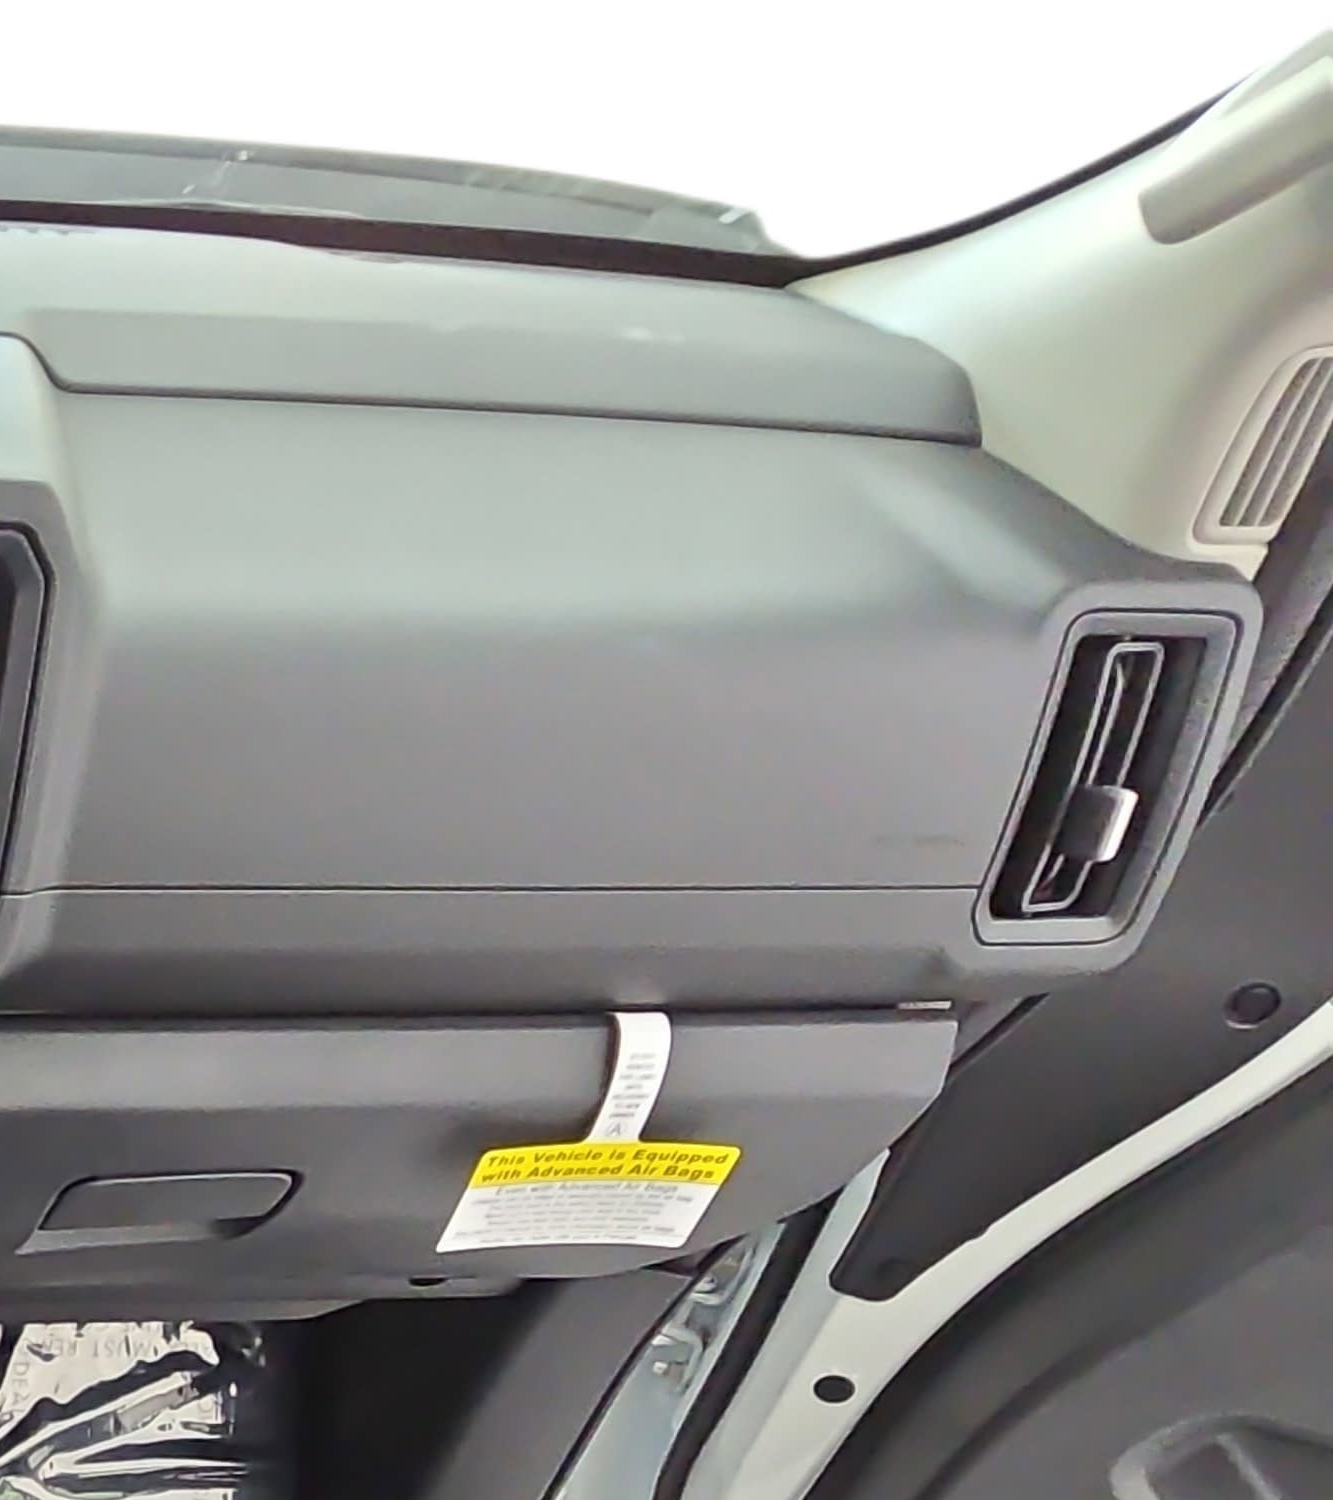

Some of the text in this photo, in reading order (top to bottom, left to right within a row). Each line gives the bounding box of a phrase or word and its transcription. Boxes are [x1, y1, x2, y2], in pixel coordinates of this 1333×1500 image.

[487, 1149, 729, 1168] This Vehicle is Equipped
[481, 1163, 715, 1182] with Advanced Air Bags
